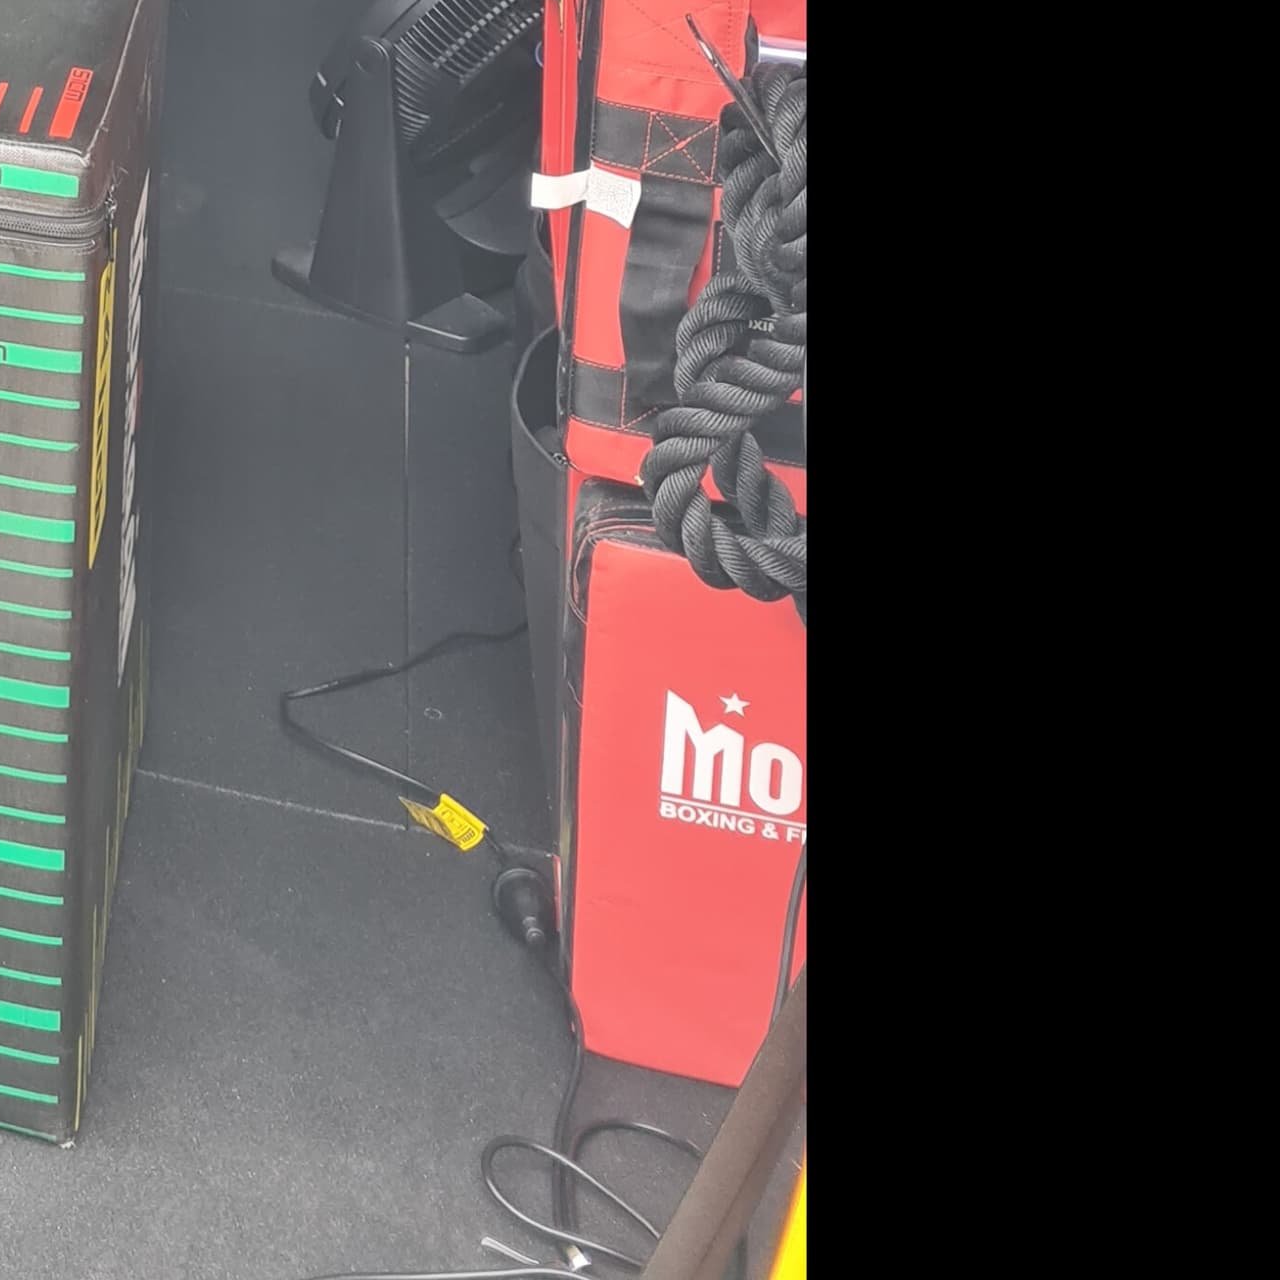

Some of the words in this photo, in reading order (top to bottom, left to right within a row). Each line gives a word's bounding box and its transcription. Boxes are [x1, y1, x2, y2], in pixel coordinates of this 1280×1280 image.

[660, 688, 804, 816] MO
[659, 801, 756, 835] BOXING
[761, 823, 780, 840] &
